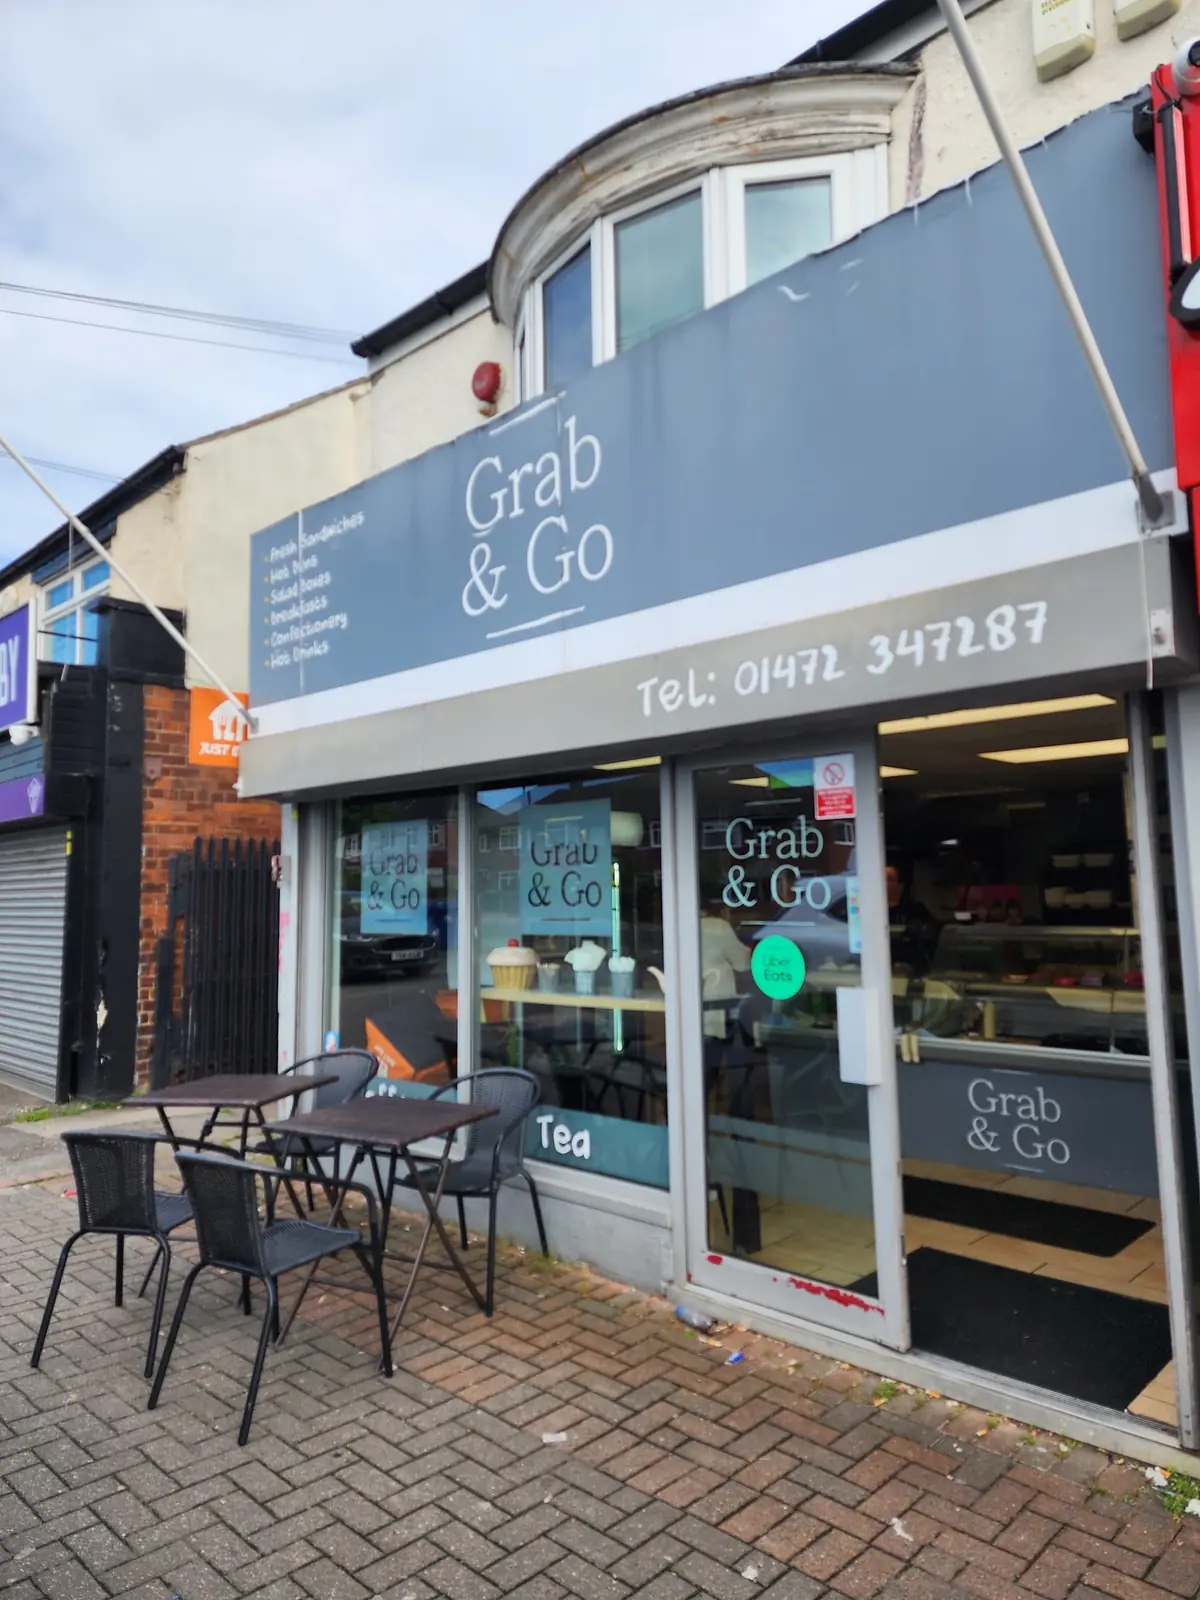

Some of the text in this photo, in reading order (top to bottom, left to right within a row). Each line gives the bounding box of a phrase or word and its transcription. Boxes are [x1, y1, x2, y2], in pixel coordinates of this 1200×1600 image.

[465, 414, 602, 531] Grab
[300, 511, 365, 549] Sandwiches
[461, 513, 614, 617] & Go
[270, 612, 348, 648] Confectionery
[733, 644, 846, 696] 01472
[866, 601, 1048, 675] 347287
[725, 815, 824, 860] Grab
[390, 879, 421, 911] Go
[527, 870, 602, 908] & Go
[722, 864, 832, 910] & Go
[764, 969, 793, 982] Eats
[967, 1078, 1062, 1123] Grab
[536, 1114, 591, 1160] Tea
[966, 1115, 1071, 1165] & Go
